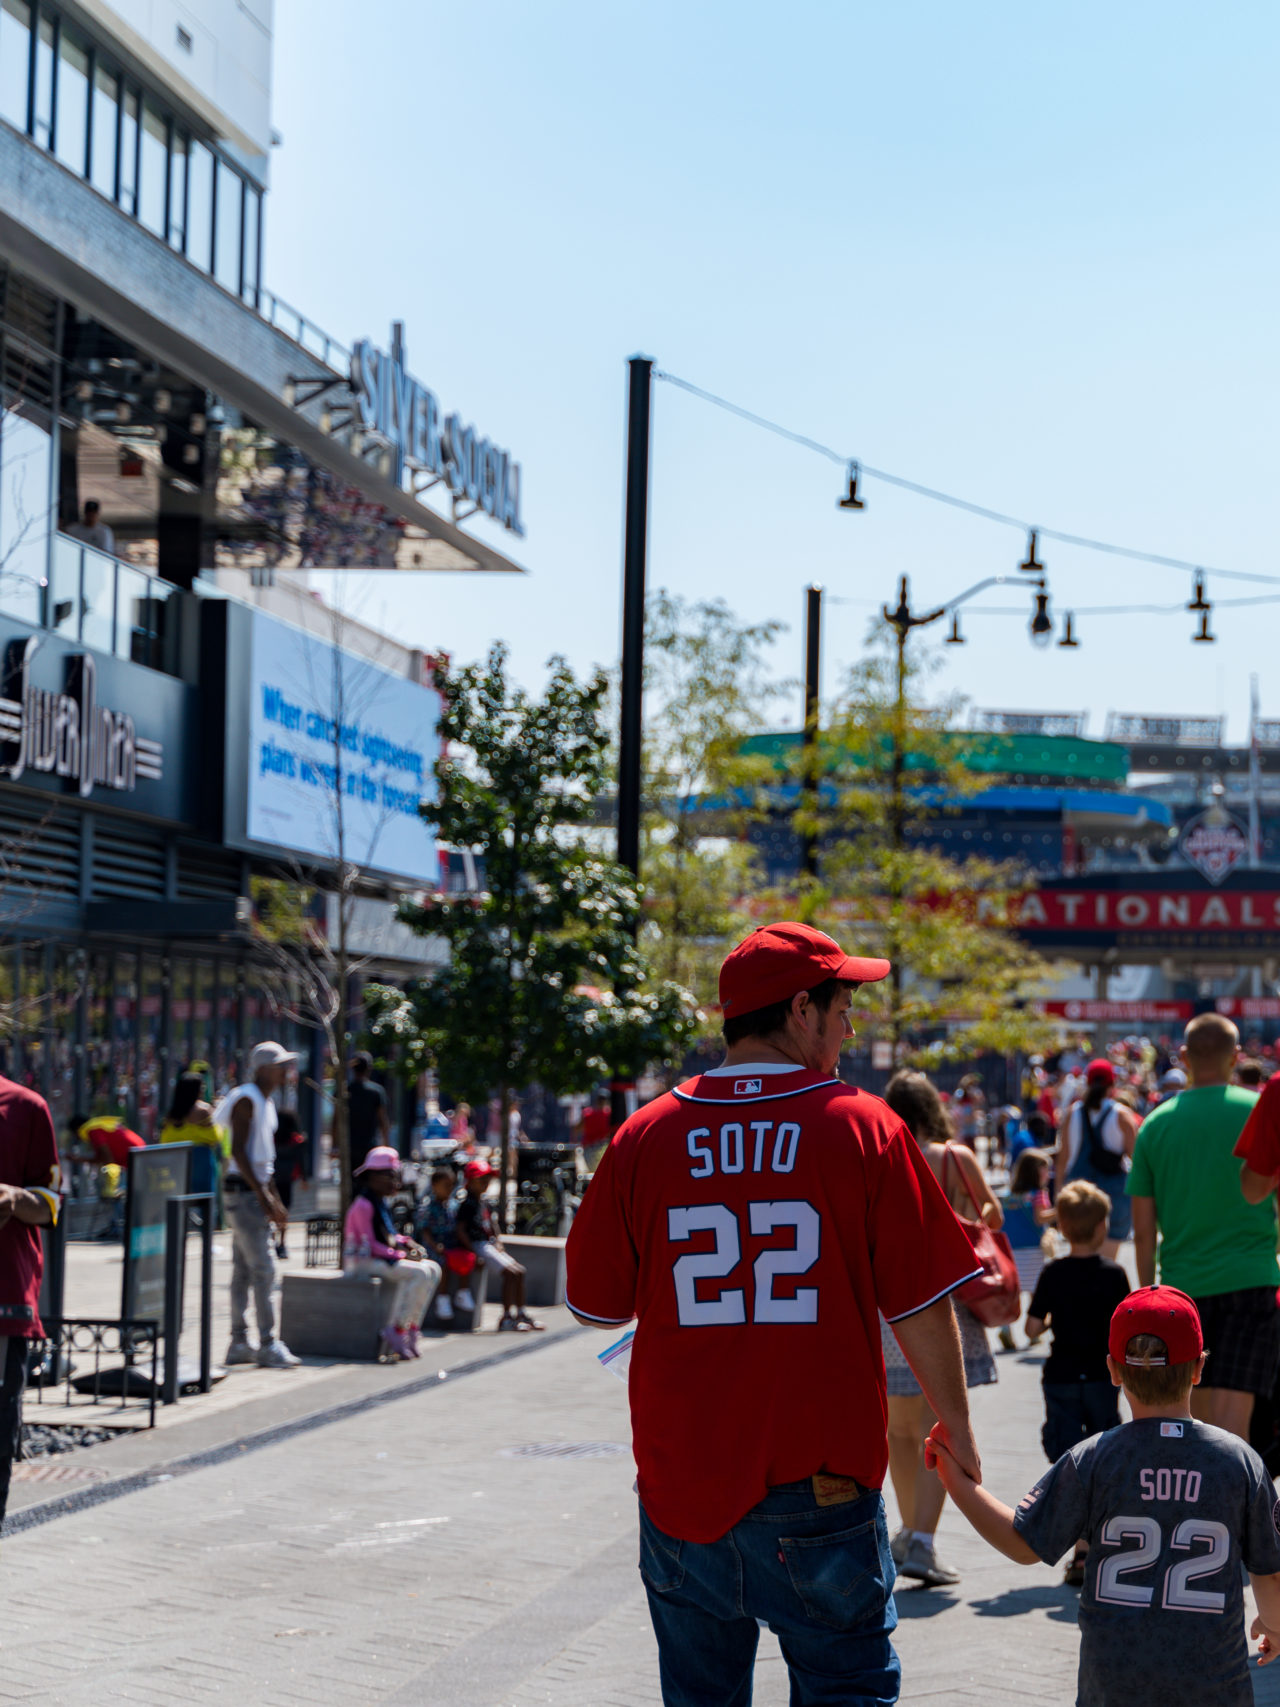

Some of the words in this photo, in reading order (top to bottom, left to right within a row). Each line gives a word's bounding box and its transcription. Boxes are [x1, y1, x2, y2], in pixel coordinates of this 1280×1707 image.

[353, 339, 444, 475] SILVER
[446, 412, 527, 537] SOCIAL
[687, 1121, 801, 1179] SOTO
[667, 1199, 821, 1327] 22
[1140, 1468, 1202, 1503] SOTO
[1095, 1516, 1230, 1614] 22
